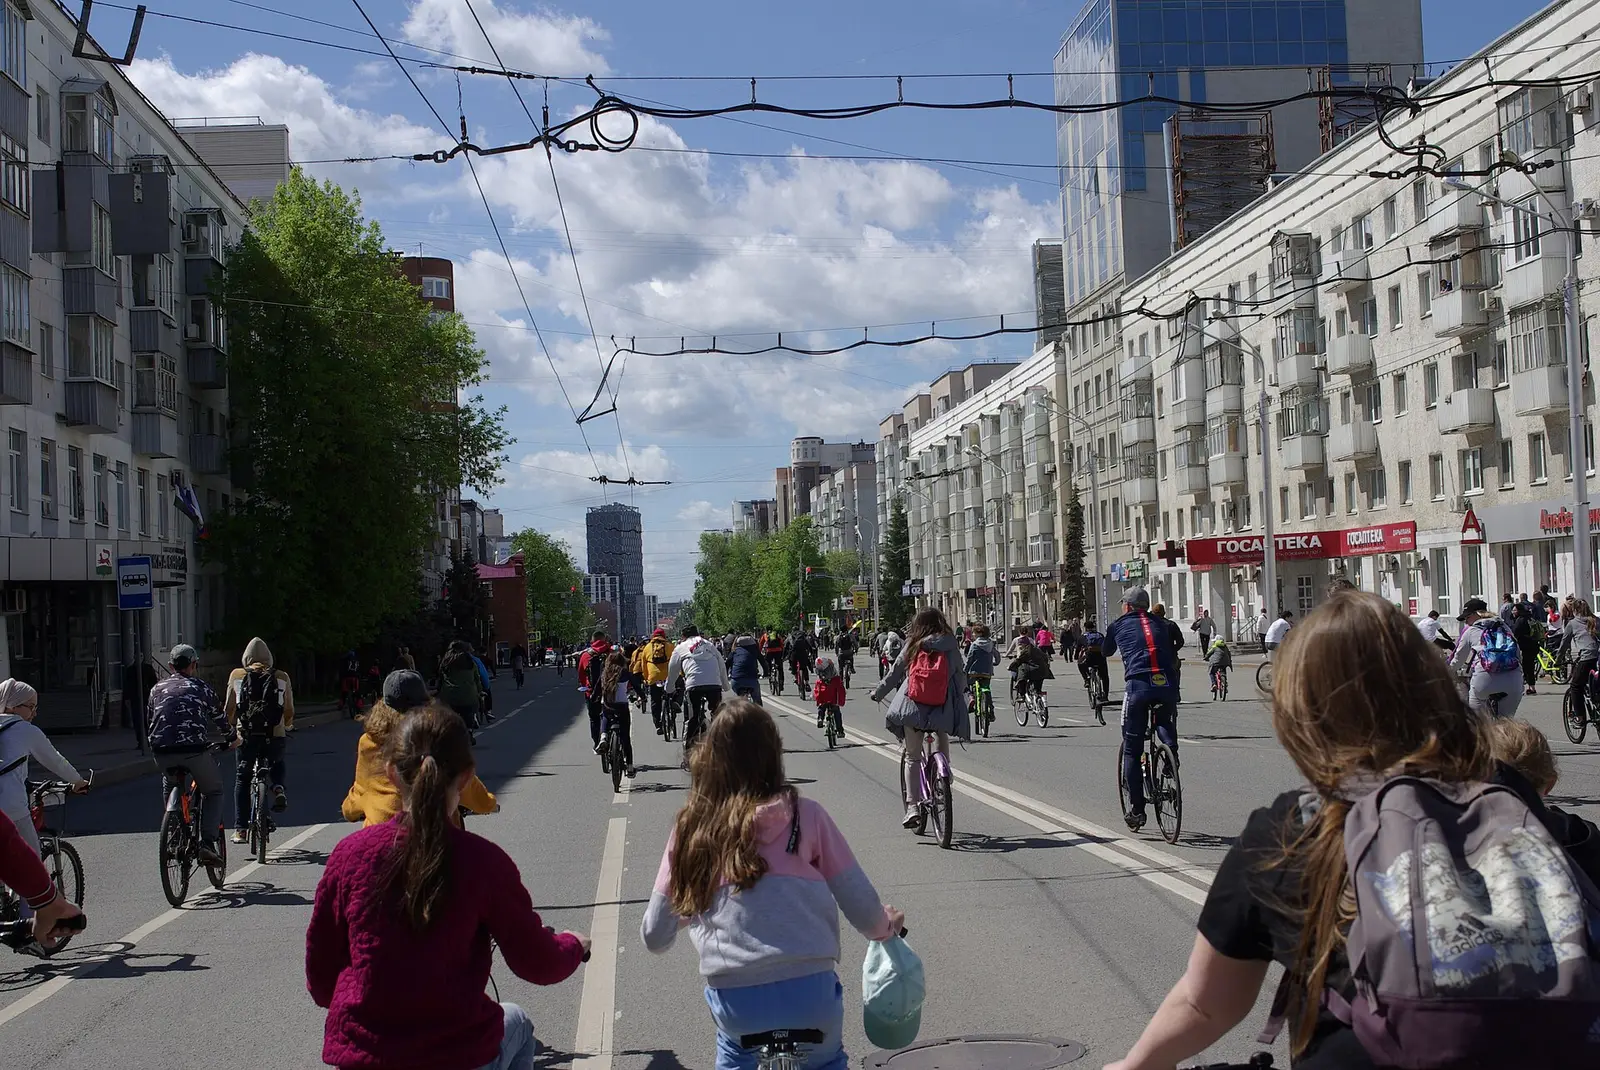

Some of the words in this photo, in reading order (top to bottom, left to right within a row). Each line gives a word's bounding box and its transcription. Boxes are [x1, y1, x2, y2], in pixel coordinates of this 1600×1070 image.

[1216, 535, 1323, 554] ГОСАТЕКА
[1346, 528, 1384, 546] ГОСАПТЕКА
[1450, 929, 1504, 955] adidas
